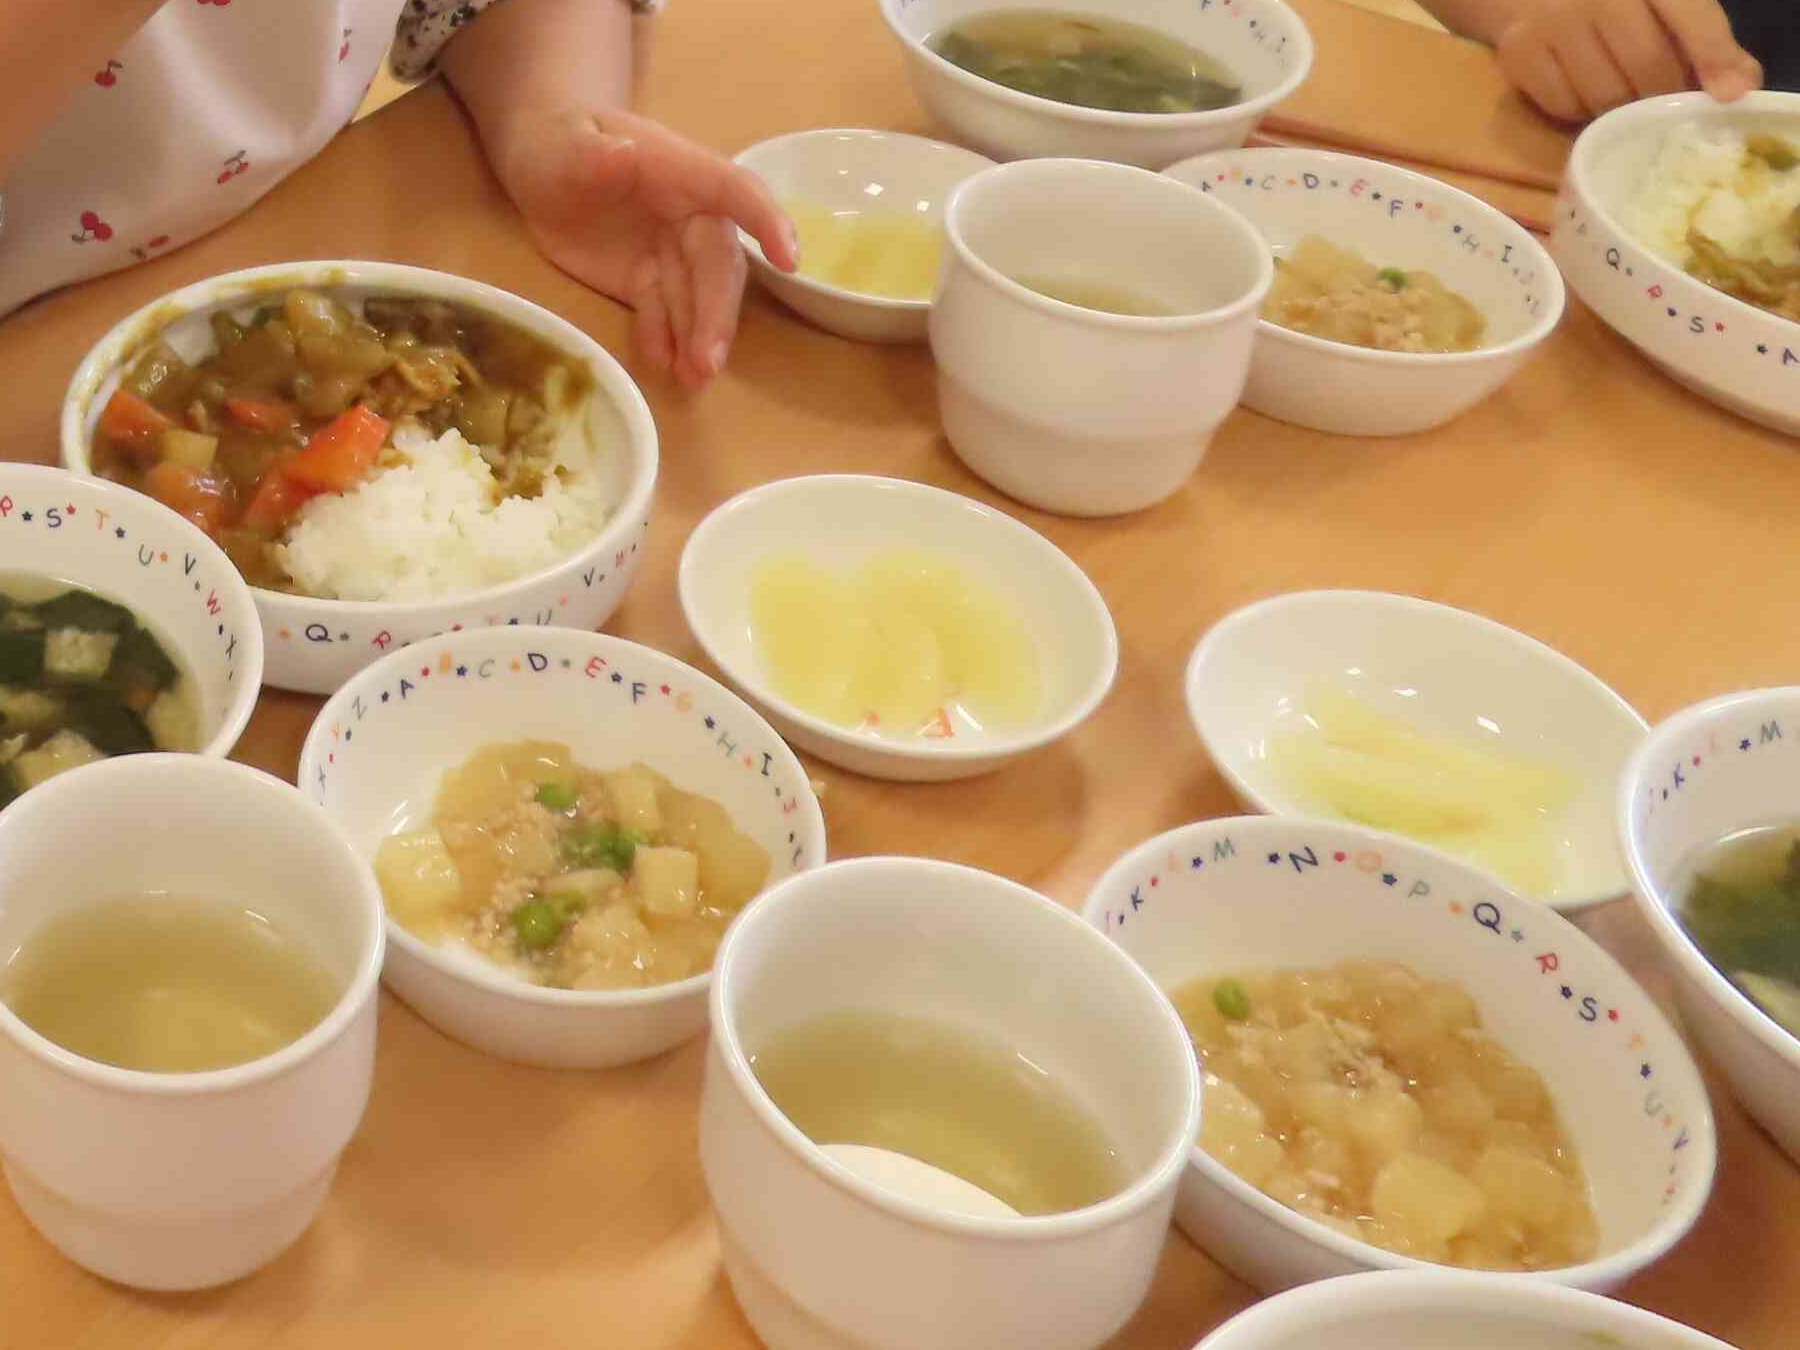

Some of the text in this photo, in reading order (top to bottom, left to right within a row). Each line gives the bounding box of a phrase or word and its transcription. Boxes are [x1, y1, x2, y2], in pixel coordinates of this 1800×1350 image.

[1303, 172, 1320, 189] D
[1390, 200, 1404, 217] F
[1605, 247, 1621, 271] Q
[1689, 316, 1705, 333] S
[46, 507, 63, 528] S
[95, 508, 111, 531] T
[138, 543, 154, 566] U
[184, 553, 196, 576] V
[305, 623, 334, 643] Q
[478, 658, 496, 679] C
[527, 652, 549, 672] D
[584, 655, 607, 679] E
[632, 681, 648, 704] F
[760, 752, 773, 777] I
[1759, 719, 1782, 745] M
[1288, 845, 1320, 874] N
[1473, 902, 1501, 935] Q
[1535, 952, 1559, 975] R
[1578, 996, 1598, 1023] S
